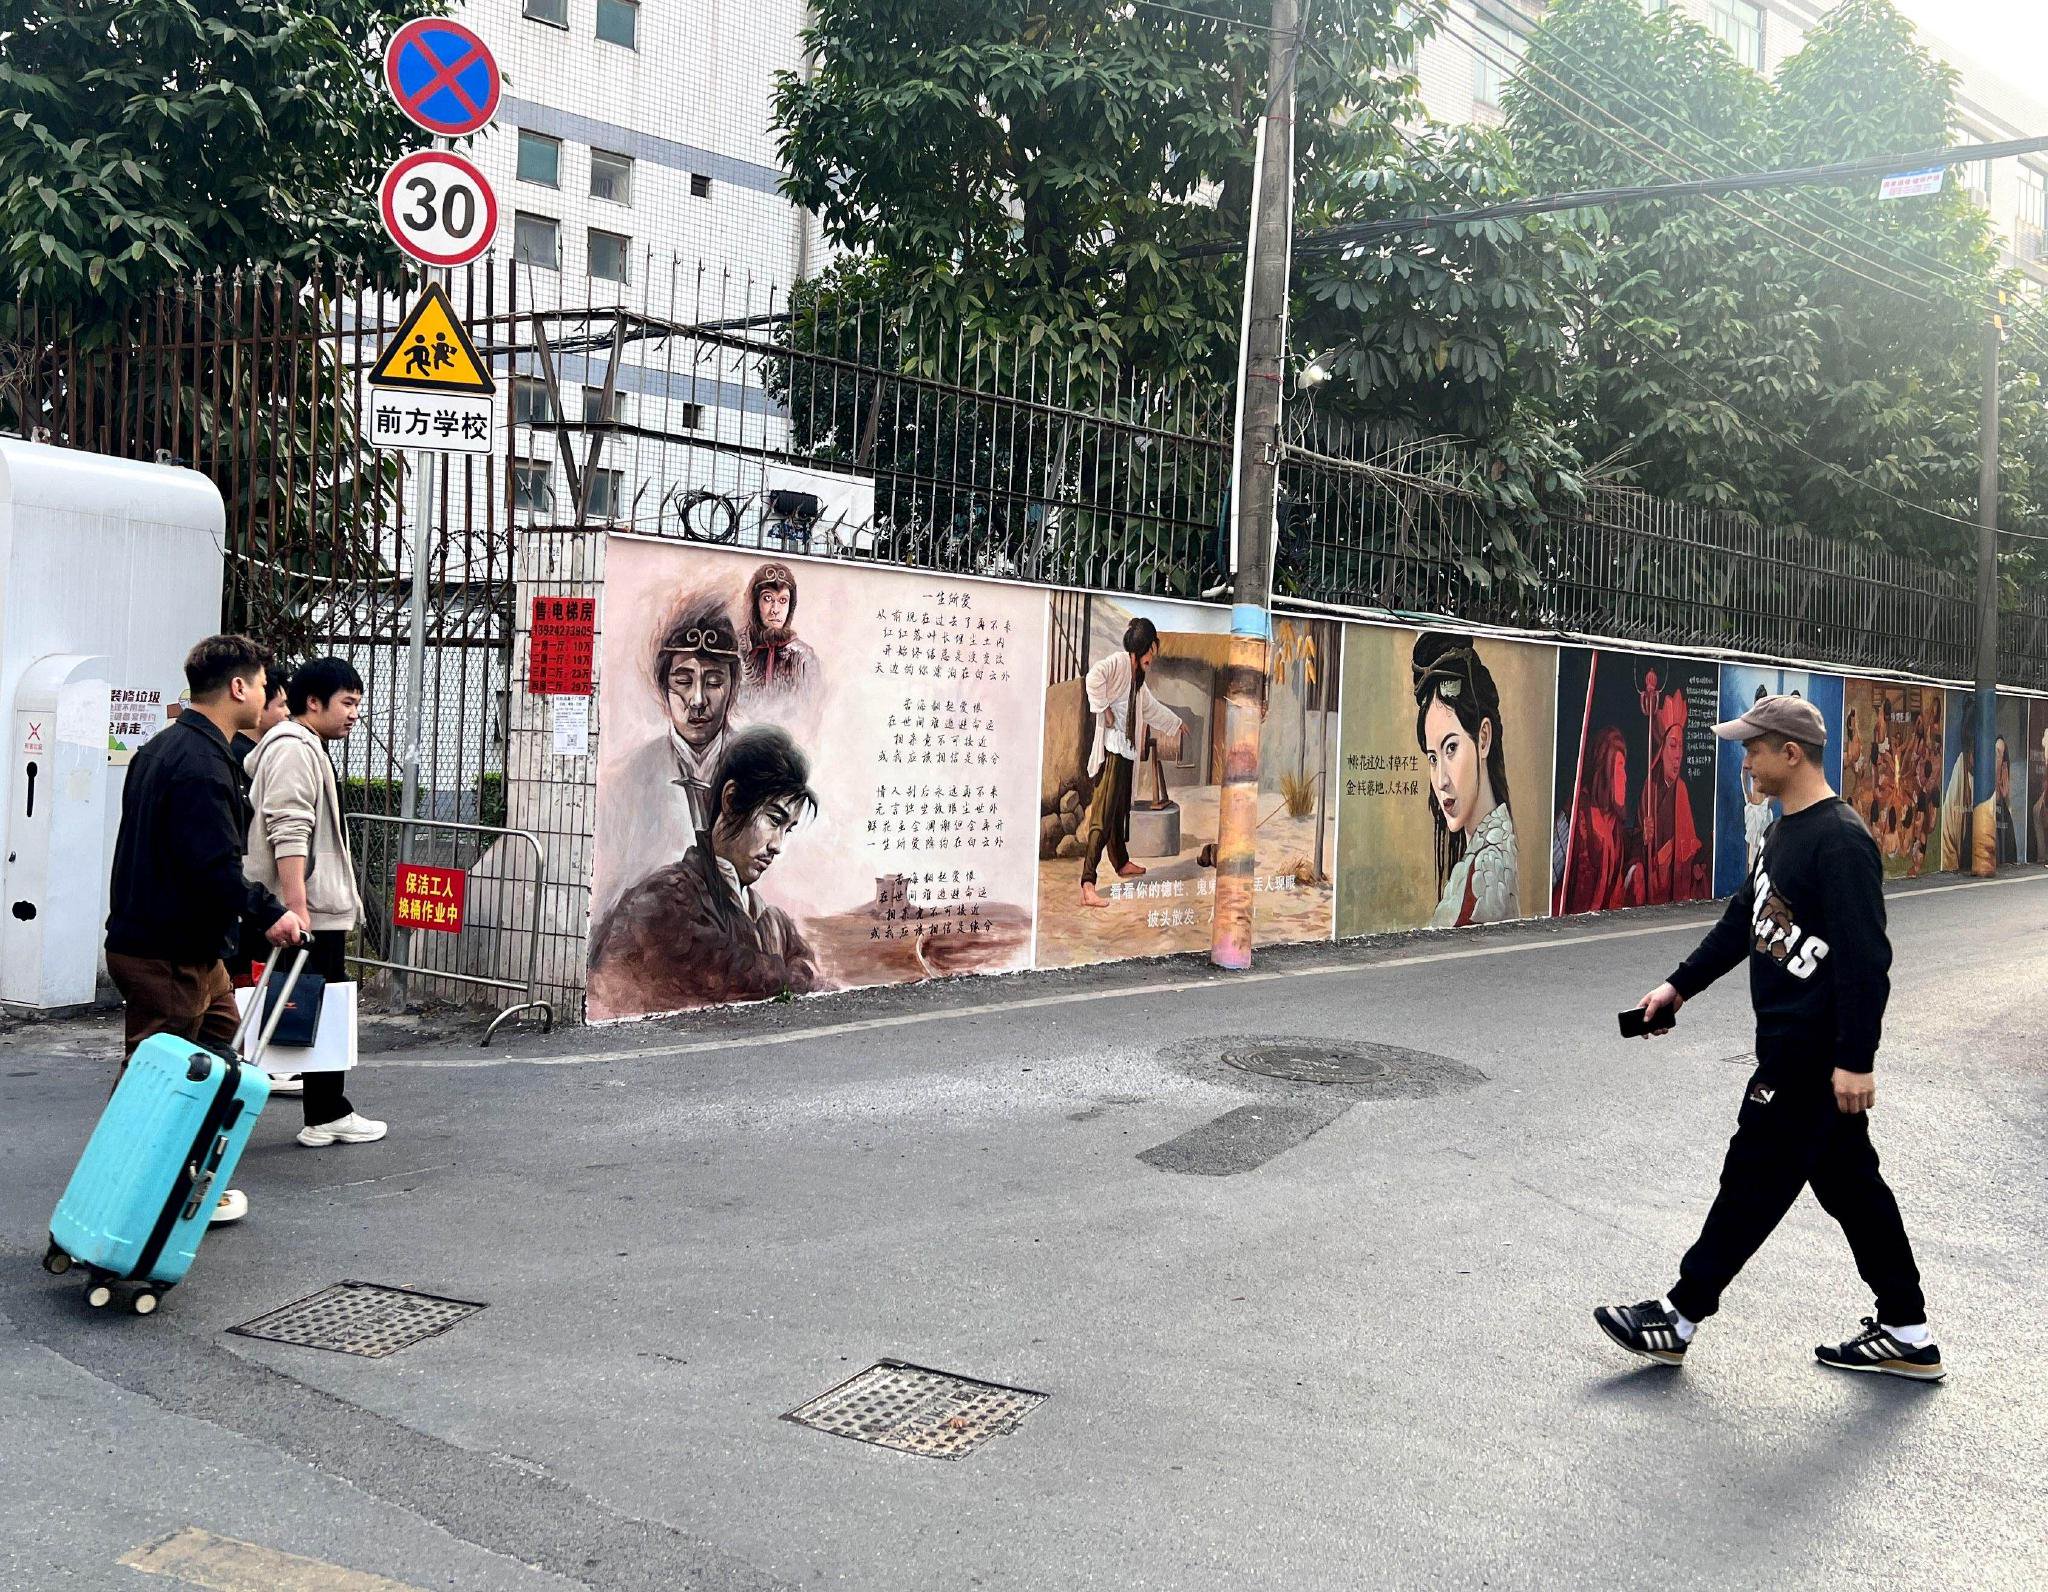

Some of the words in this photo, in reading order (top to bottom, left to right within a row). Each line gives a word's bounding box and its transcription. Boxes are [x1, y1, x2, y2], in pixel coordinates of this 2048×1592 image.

[402, 177, 475, 239] 30
[376, 404, 488, 440] 前方学校
[535, 601, 593, 622] 售电梯房
[922, 591, 972, 610] 一生所爱
[405, 872, 453, 898] 保洁工人
[398, 897, 458, 926] 换桶作业中
